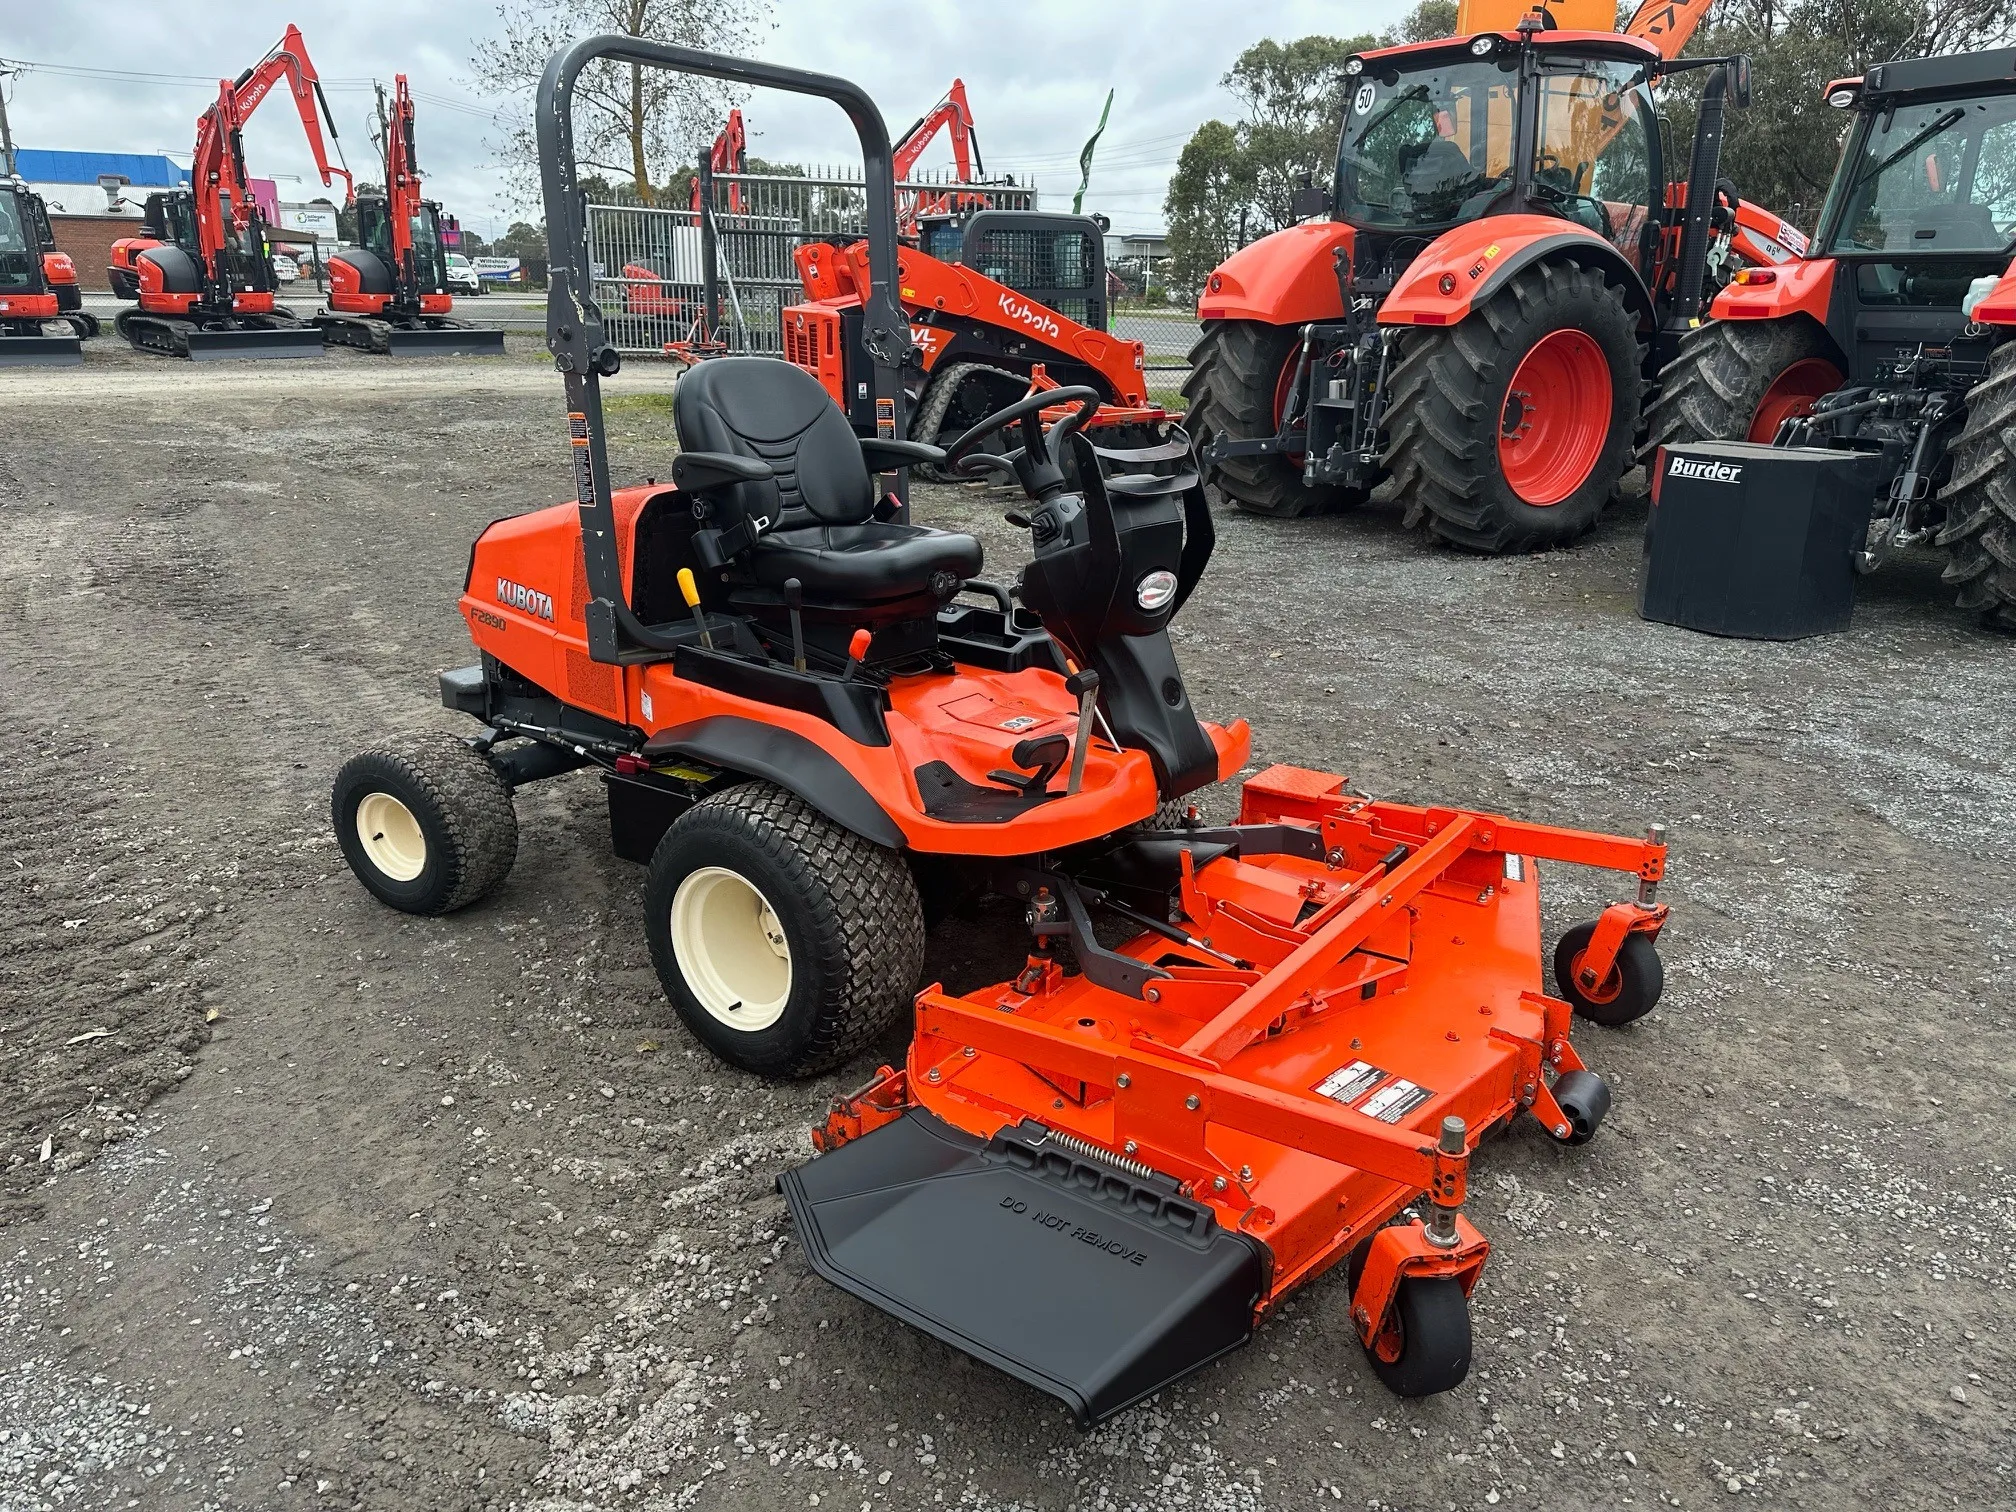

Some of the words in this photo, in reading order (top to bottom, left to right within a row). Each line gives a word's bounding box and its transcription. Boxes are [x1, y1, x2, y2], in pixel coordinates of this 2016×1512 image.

[239, 83, 266, 111] Kubota
[1358, 88, 1373, 109] 50
[911, 129, 933, 154] Kubota
[998, 292, 1059, 339] Kubota
[910, 342, 937, 353] 7-2
[1668, 456, 1742, 482] Burder
[496, 576, 555, 623] KUBOTA
[471, 606, 507, 632] F2890
[999, 1196, 1028, 1214] DO
[1032, 1210, 1071, 1232] NOT
[1070, 1226, 1148, 1267] REMOVE
